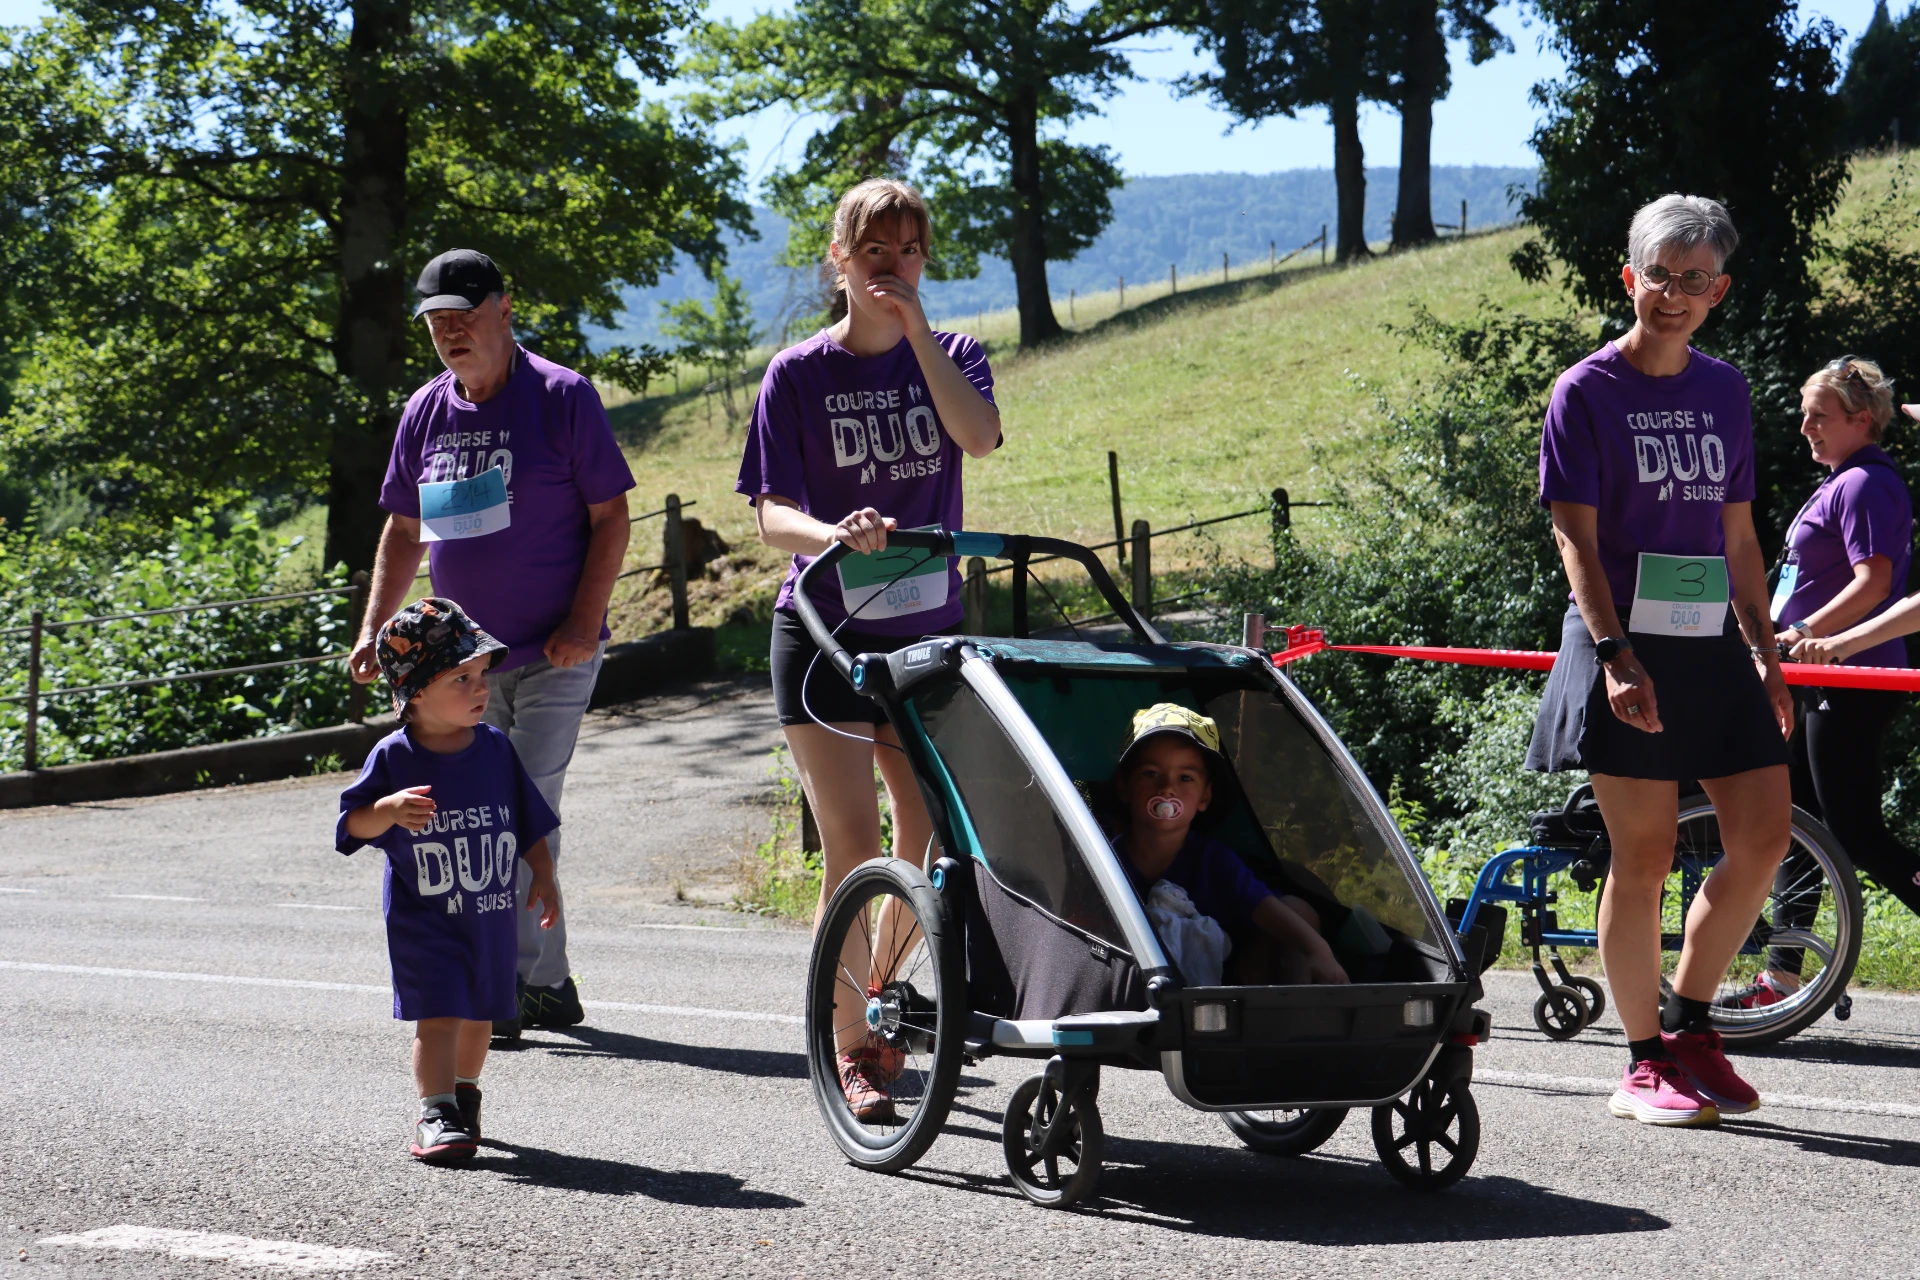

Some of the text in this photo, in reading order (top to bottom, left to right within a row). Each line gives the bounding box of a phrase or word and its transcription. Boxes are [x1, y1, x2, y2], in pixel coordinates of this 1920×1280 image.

[825, 389, 901, 413] COURSE
[1626, 411, 1697, 430] COURSE
[435, 430, 492, 449] COURSE
[830, 405, 941, 468] DUO
[1633, 433, 1726, 483] DUO
[889, 456, 942, 481] SUISSE
[1682, 485, 1725, 502] SUISSE
[453, 518, 482, 532] DUO
[1674, 562, 1707, 597] 3
[885, 585, 921, 606] DUO
[1670, 610, 1701, 625] DUO
[907, 646, 932, 664] THULE
[412, 831, 517, 896] DUO
[1091, 942, 1105, 955] LITE
